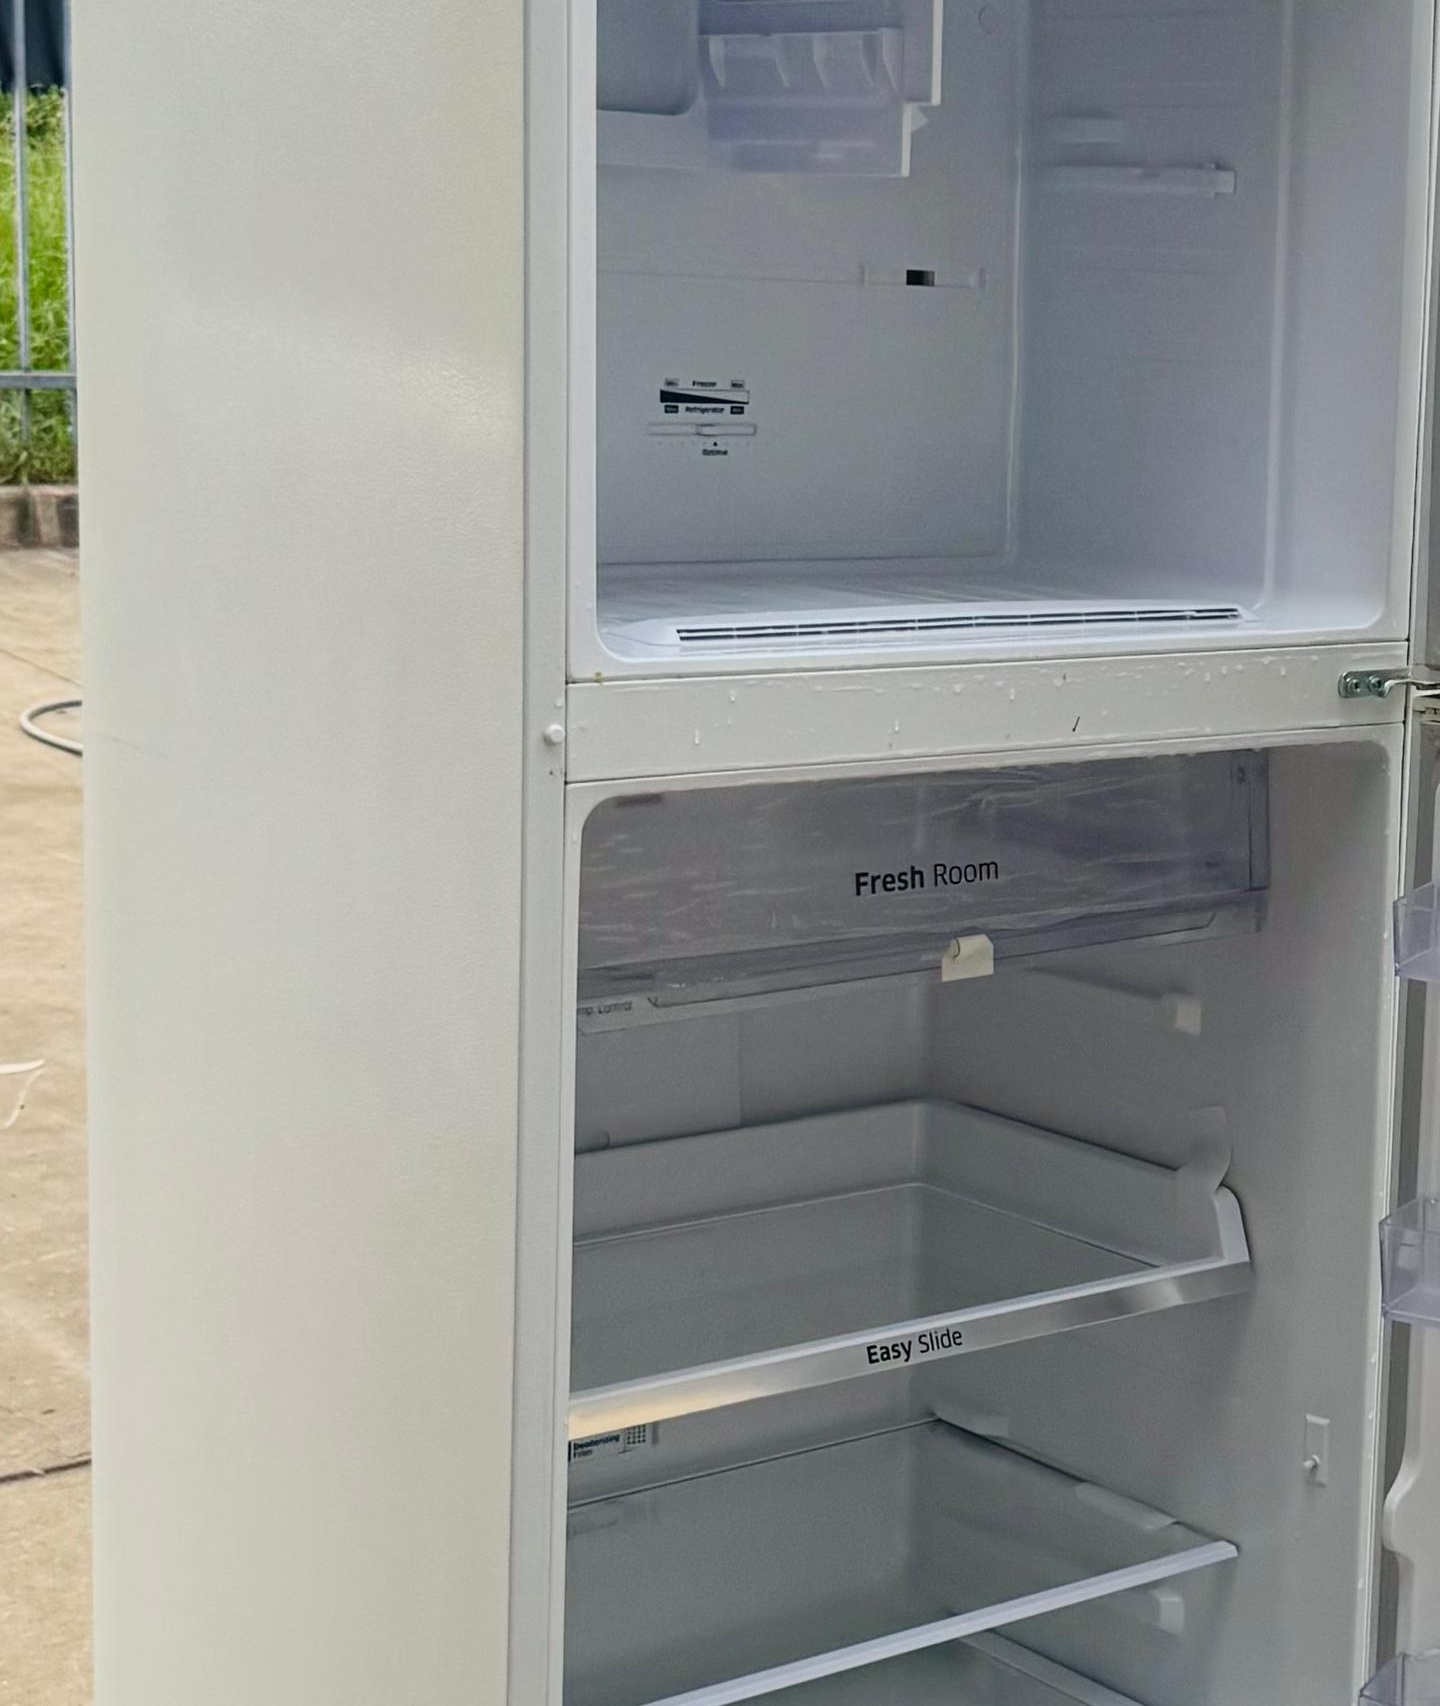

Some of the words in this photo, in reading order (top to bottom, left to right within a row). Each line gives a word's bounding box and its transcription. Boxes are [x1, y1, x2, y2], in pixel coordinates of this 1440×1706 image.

[855, 864, 925, 896] Fresh
[933, 860, 999, 887] Room
[866, 1340, 912, 1364] Easy
[918, 1327, 963, 1354] Slide
